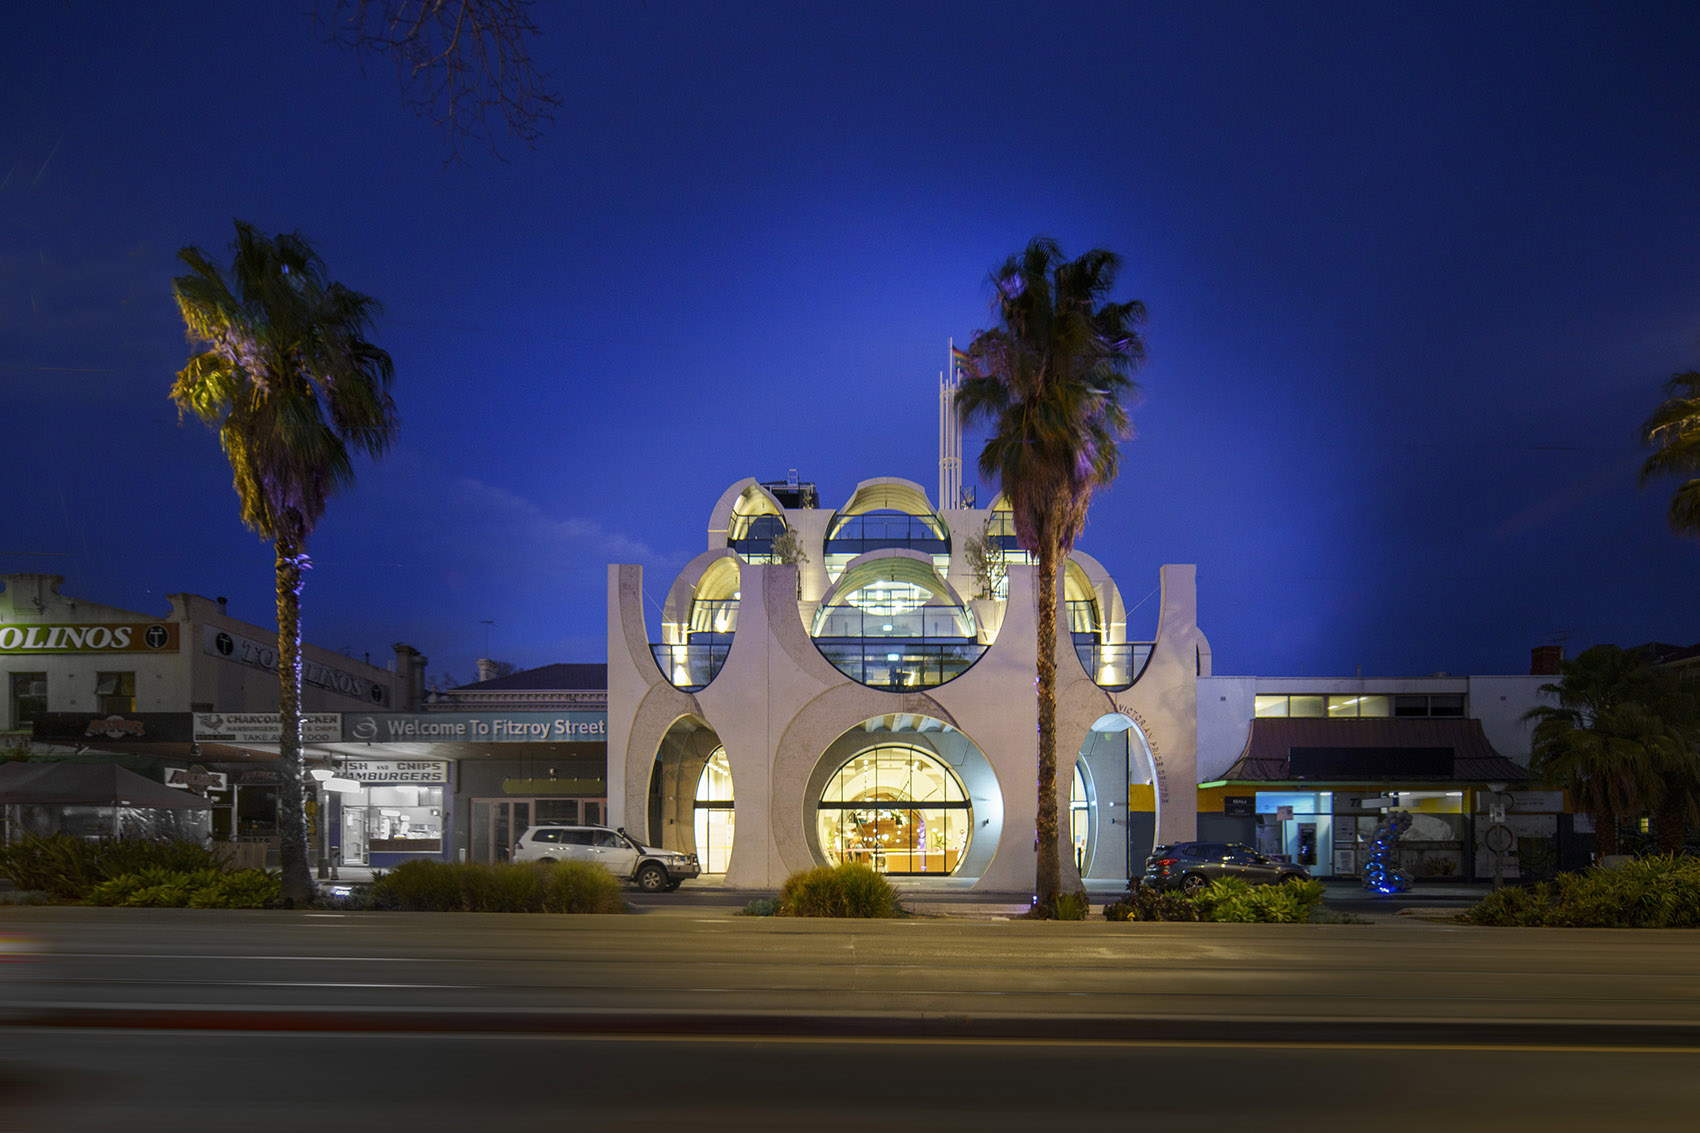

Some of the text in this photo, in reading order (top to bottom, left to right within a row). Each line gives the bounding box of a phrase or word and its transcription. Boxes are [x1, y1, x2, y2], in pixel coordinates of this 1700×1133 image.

[242, 640, 363, 696] TOLINOS
[226, 715, 282, 724] CHARCOA
[387, 719, 606, 739] Welcome To Fitzroy Street
[396, 762, 441, 771] CHIPS
